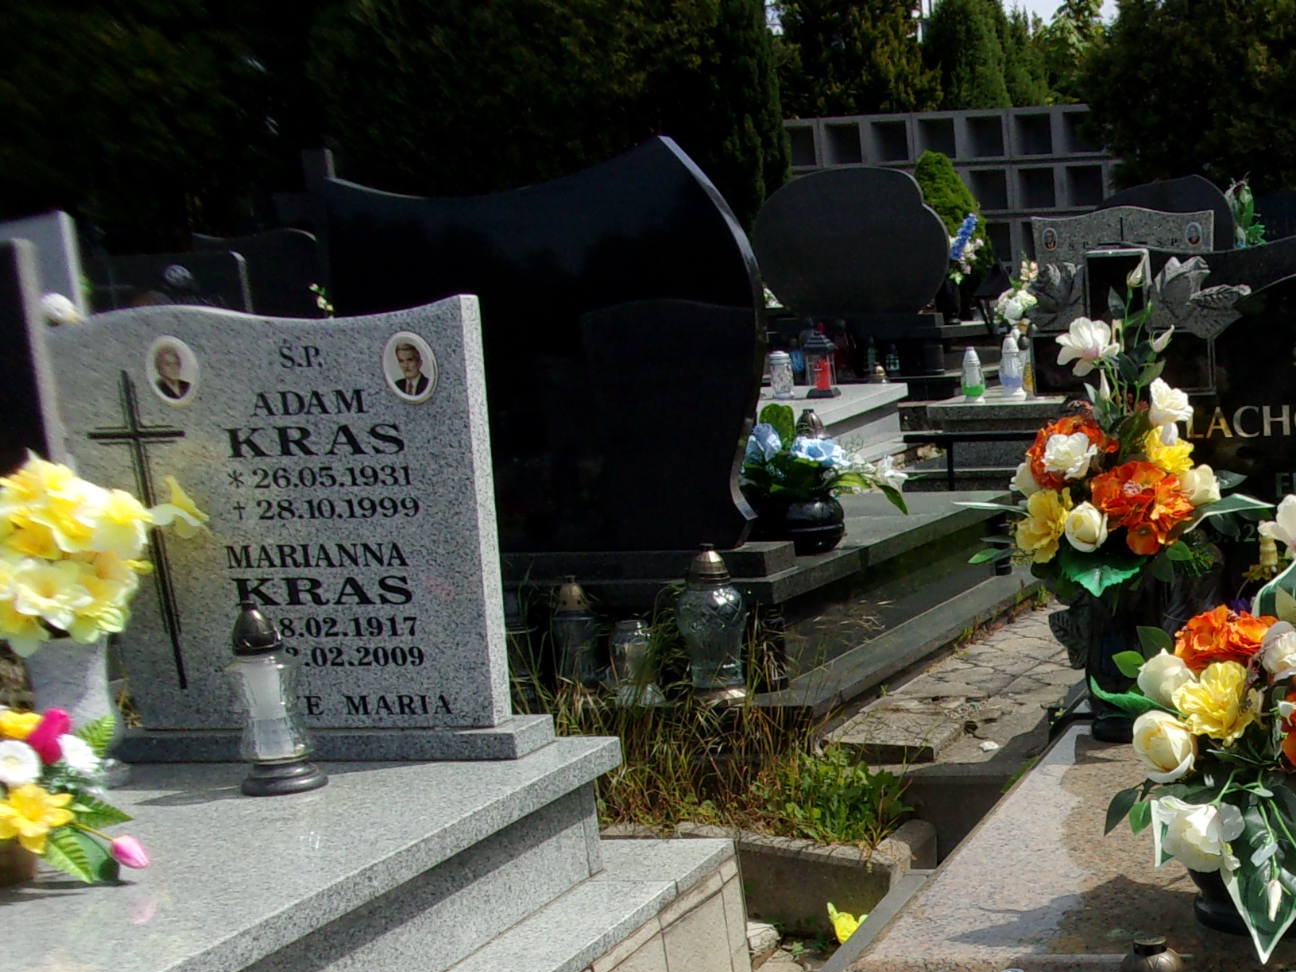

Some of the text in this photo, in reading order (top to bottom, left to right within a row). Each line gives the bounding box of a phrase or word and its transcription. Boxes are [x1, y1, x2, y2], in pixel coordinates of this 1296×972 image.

[250, 388, 366, 418] ADAM
[225, 422, 406, 459] KRAS
[226, 542, 409, 570] MARIANNA
[232, 574, 414, 608] KRAS
[279, 616, 418, 638] 8.02.1917
[343, 693, 454, 716] MARIA
